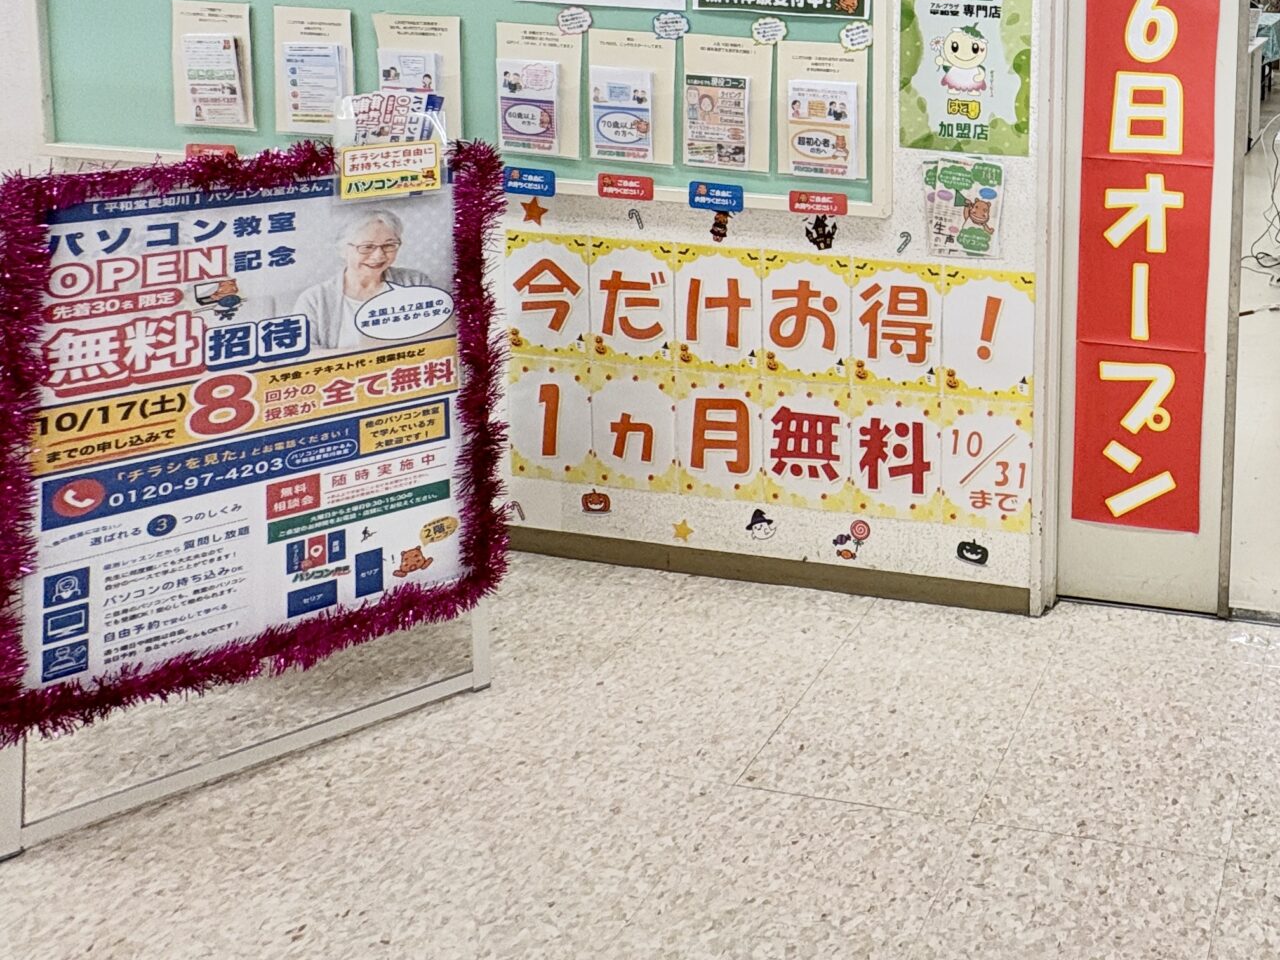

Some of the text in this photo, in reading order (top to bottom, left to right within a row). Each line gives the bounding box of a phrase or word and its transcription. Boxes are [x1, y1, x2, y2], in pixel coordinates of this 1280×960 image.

[963, 5, 1001, 18] 専門店
[939, 122, 988, 139] 加盟店
[49, 245, 296, 298] OPEN 記念
[138, 291, 175, 308] 限定
[45, 316, 301, 385] 無料 招待
[265, 384, 316, 403] 回分の
[323, 359, 454, 407] 全て無料
[189, 374, 255, 435] 8
[265, 400, 316, 421] 授業が
[47, 429, 176, 463] までの申し込みで
[110, 456, 283, 508] 0120-97-4203
[274, 495, 314, 512] 相談会
[970, 490, 1019, 512] まで
